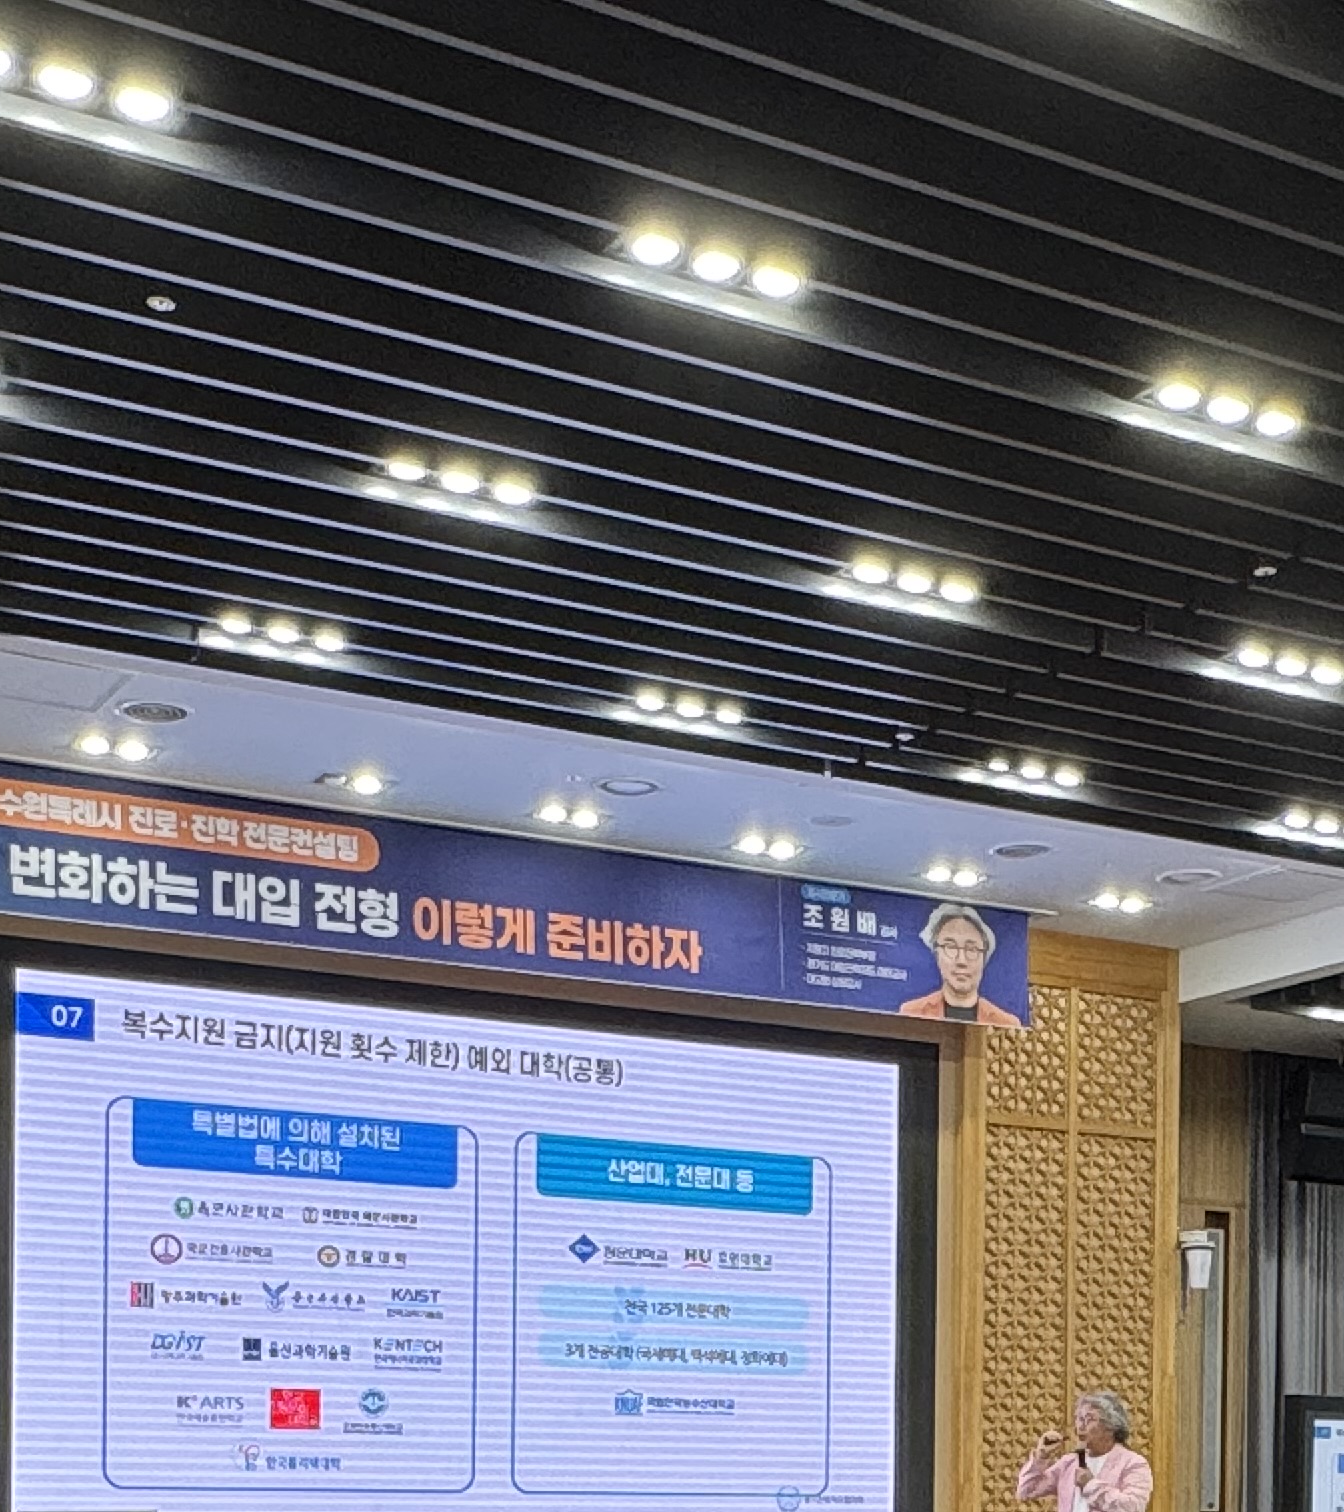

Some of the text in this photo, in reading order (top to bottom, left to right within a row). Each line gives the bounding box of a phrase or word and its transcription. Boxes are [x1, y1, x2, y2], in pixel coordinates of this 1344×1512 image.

[243, 821, 359, 862] 전문컨설팅
[9, 843, 703, 974] 변화하는 대입 전형 이렇게 준비하자
[51, 1004, 84, 1028] 07
[122, 1008, 624, 1087] 복수지원 금지(지원 횟수 제한) 예외 대학(공통)
[192, 1109, 401, 1152] 특별법에 의해 설치된
[254, 1143, 344, 1176] 특수대학
[608, 1158, 755, 1194] 산업대, 전문대 등
[391, 1288, 442, 1303] KAIST
